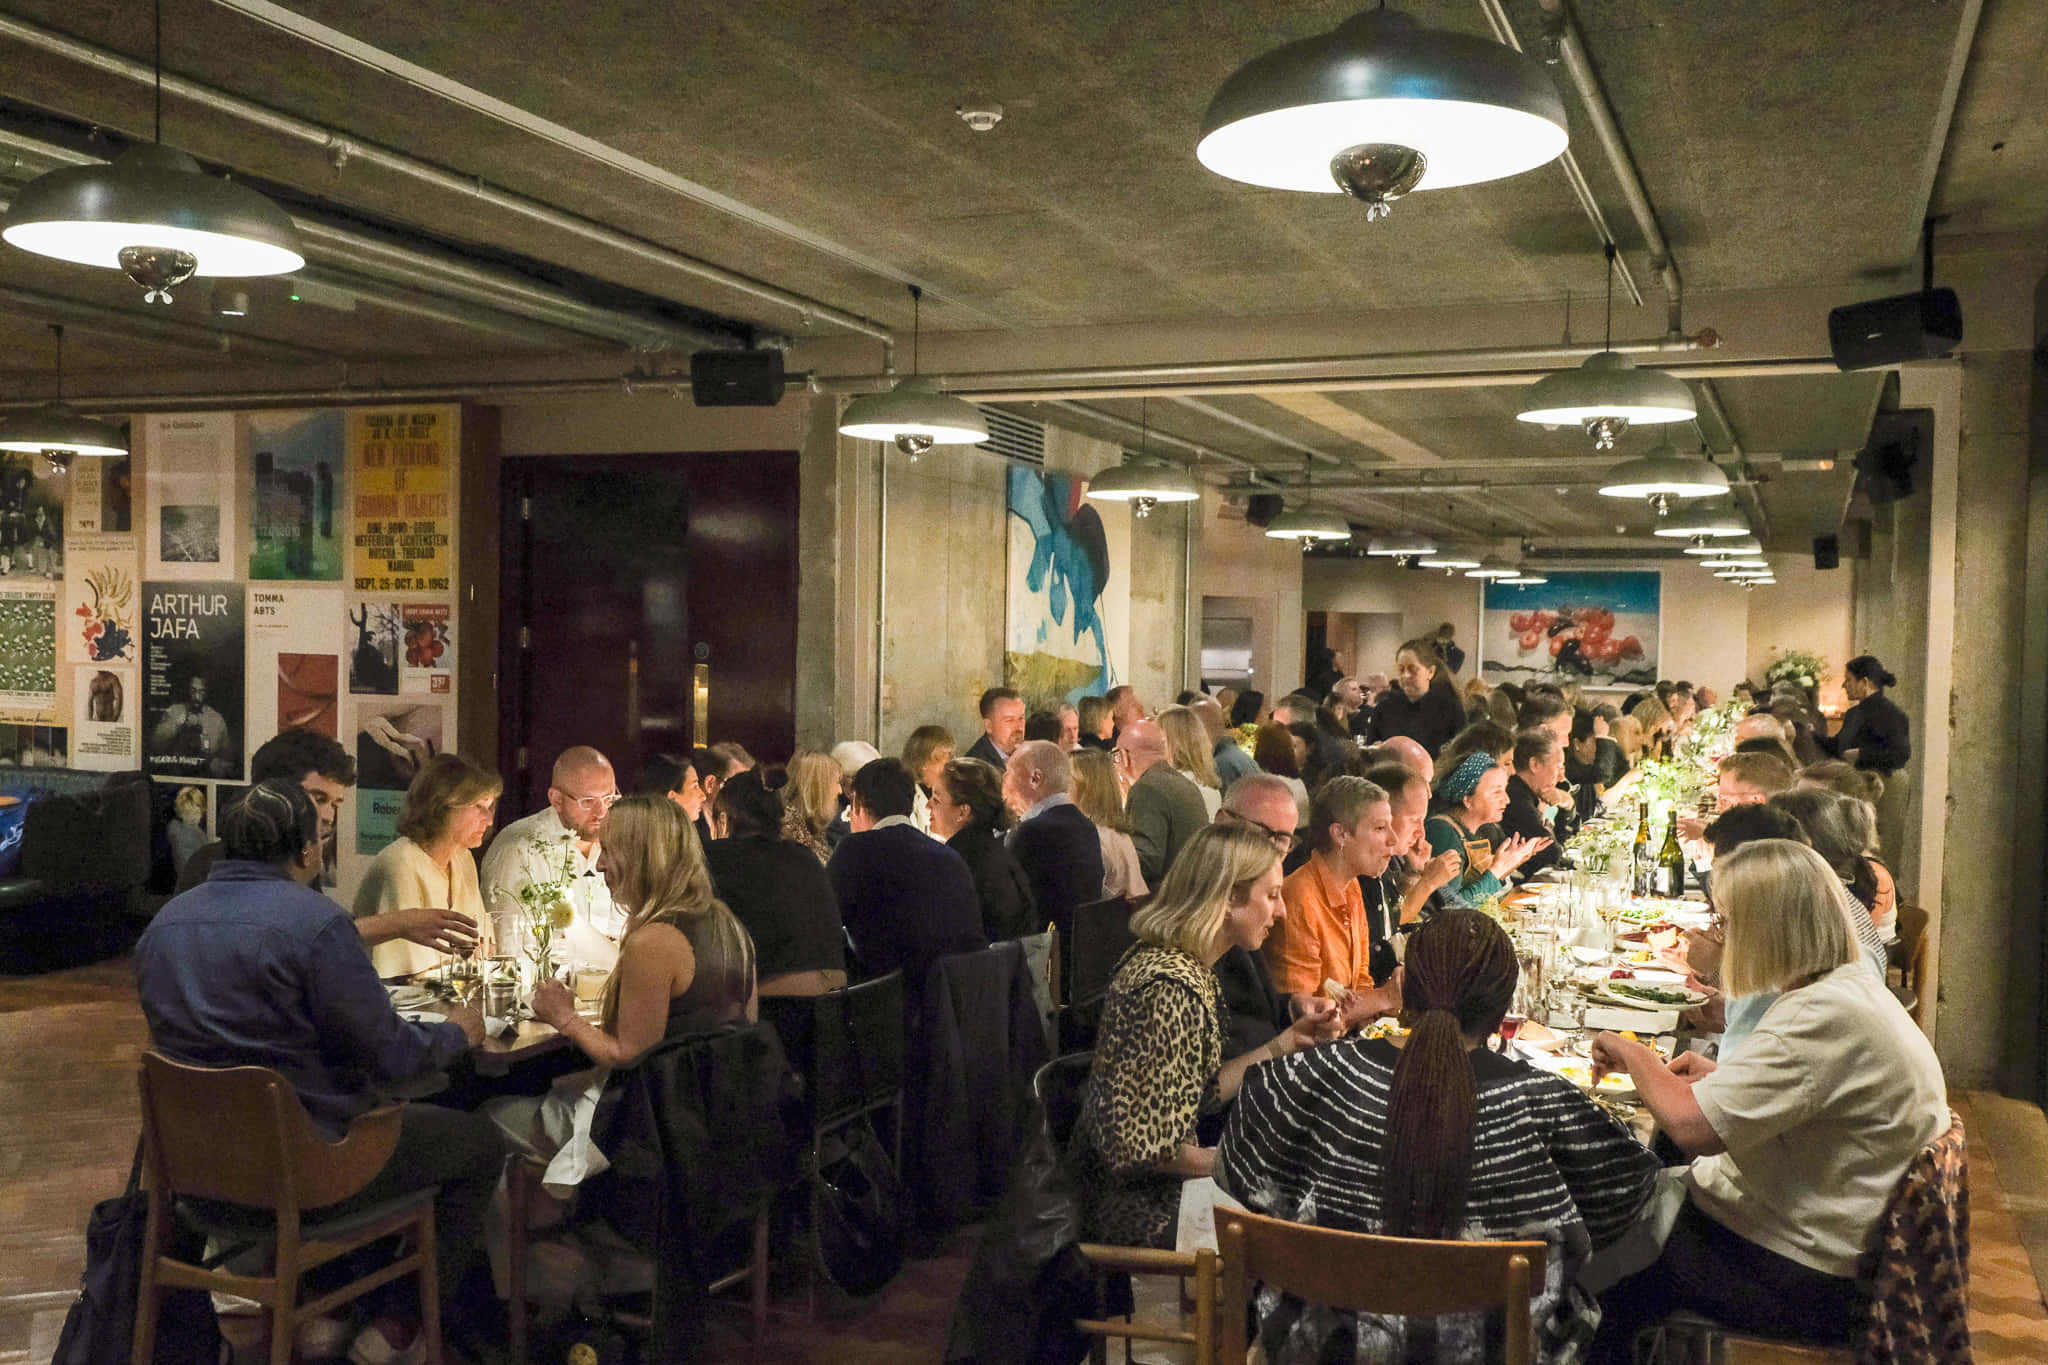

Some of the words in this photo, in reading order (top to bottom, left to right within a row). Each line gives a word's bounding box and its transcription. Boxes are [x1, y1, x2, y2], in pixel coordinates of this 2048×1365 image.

[150, 593, 228, 616] ARTHUR
[254, 593, 285, 603] TOMMA
[254, 606, 276, 616] ABTS
[150, 617, 200, 639] JAFA
